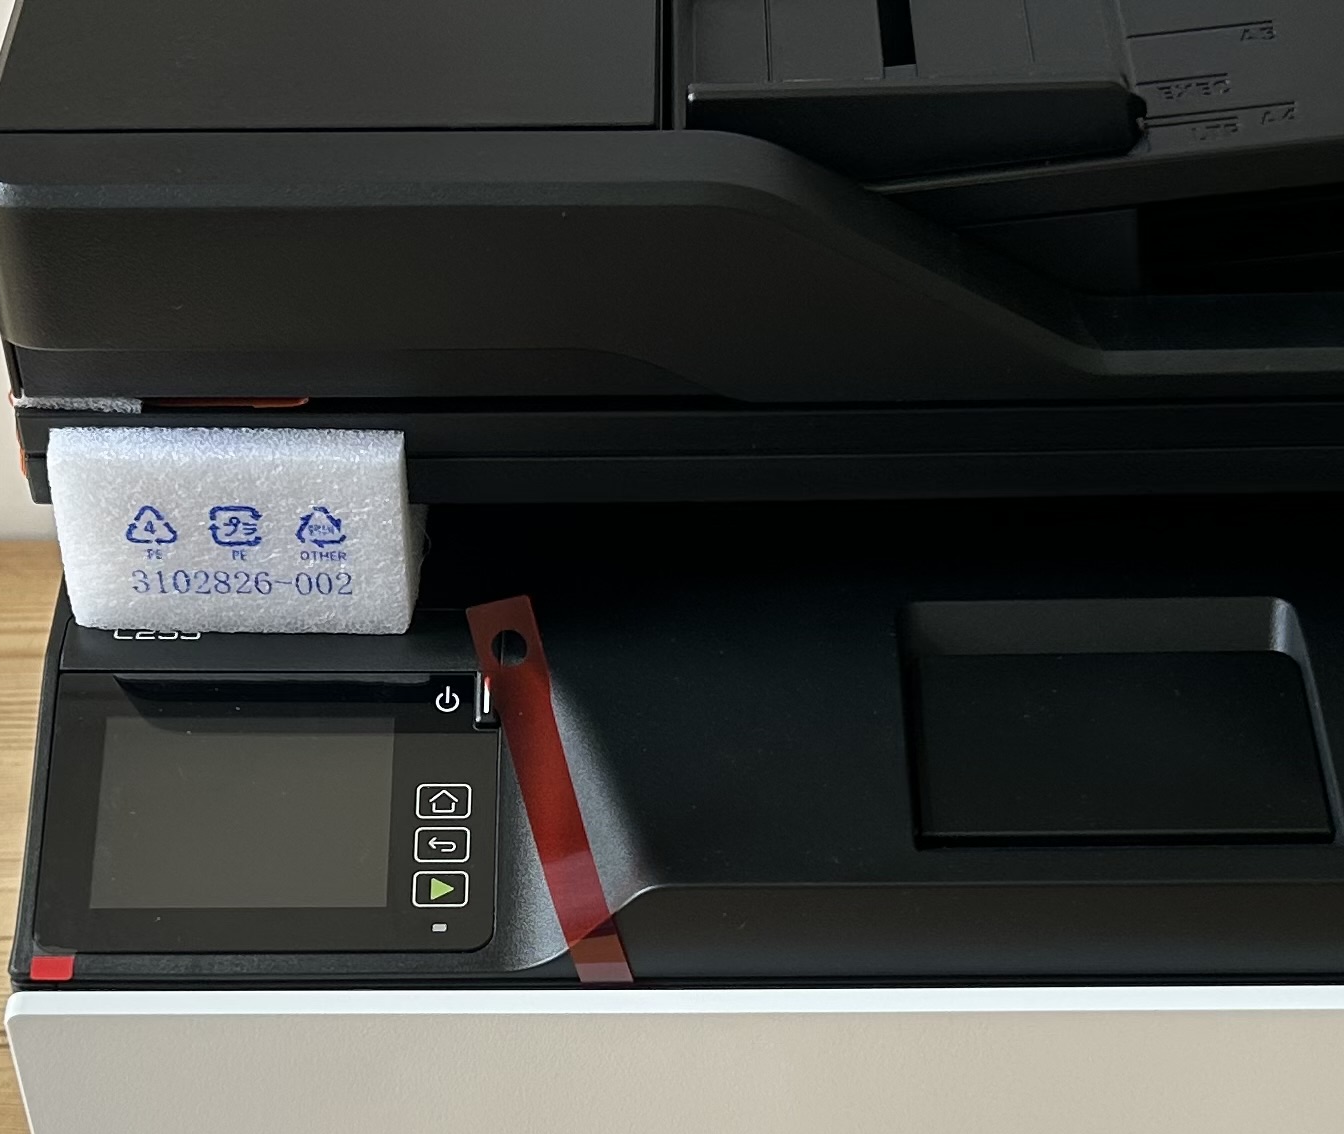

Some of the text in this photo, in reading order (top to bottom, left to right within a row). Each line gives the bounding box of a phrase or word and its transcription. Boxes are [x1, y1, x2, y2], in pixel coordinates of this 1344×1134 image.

[231, 549, 248, 561] PE
[299, 550, 347, 562] OTHER
[131, 568, 354, 596] 3102826-002
